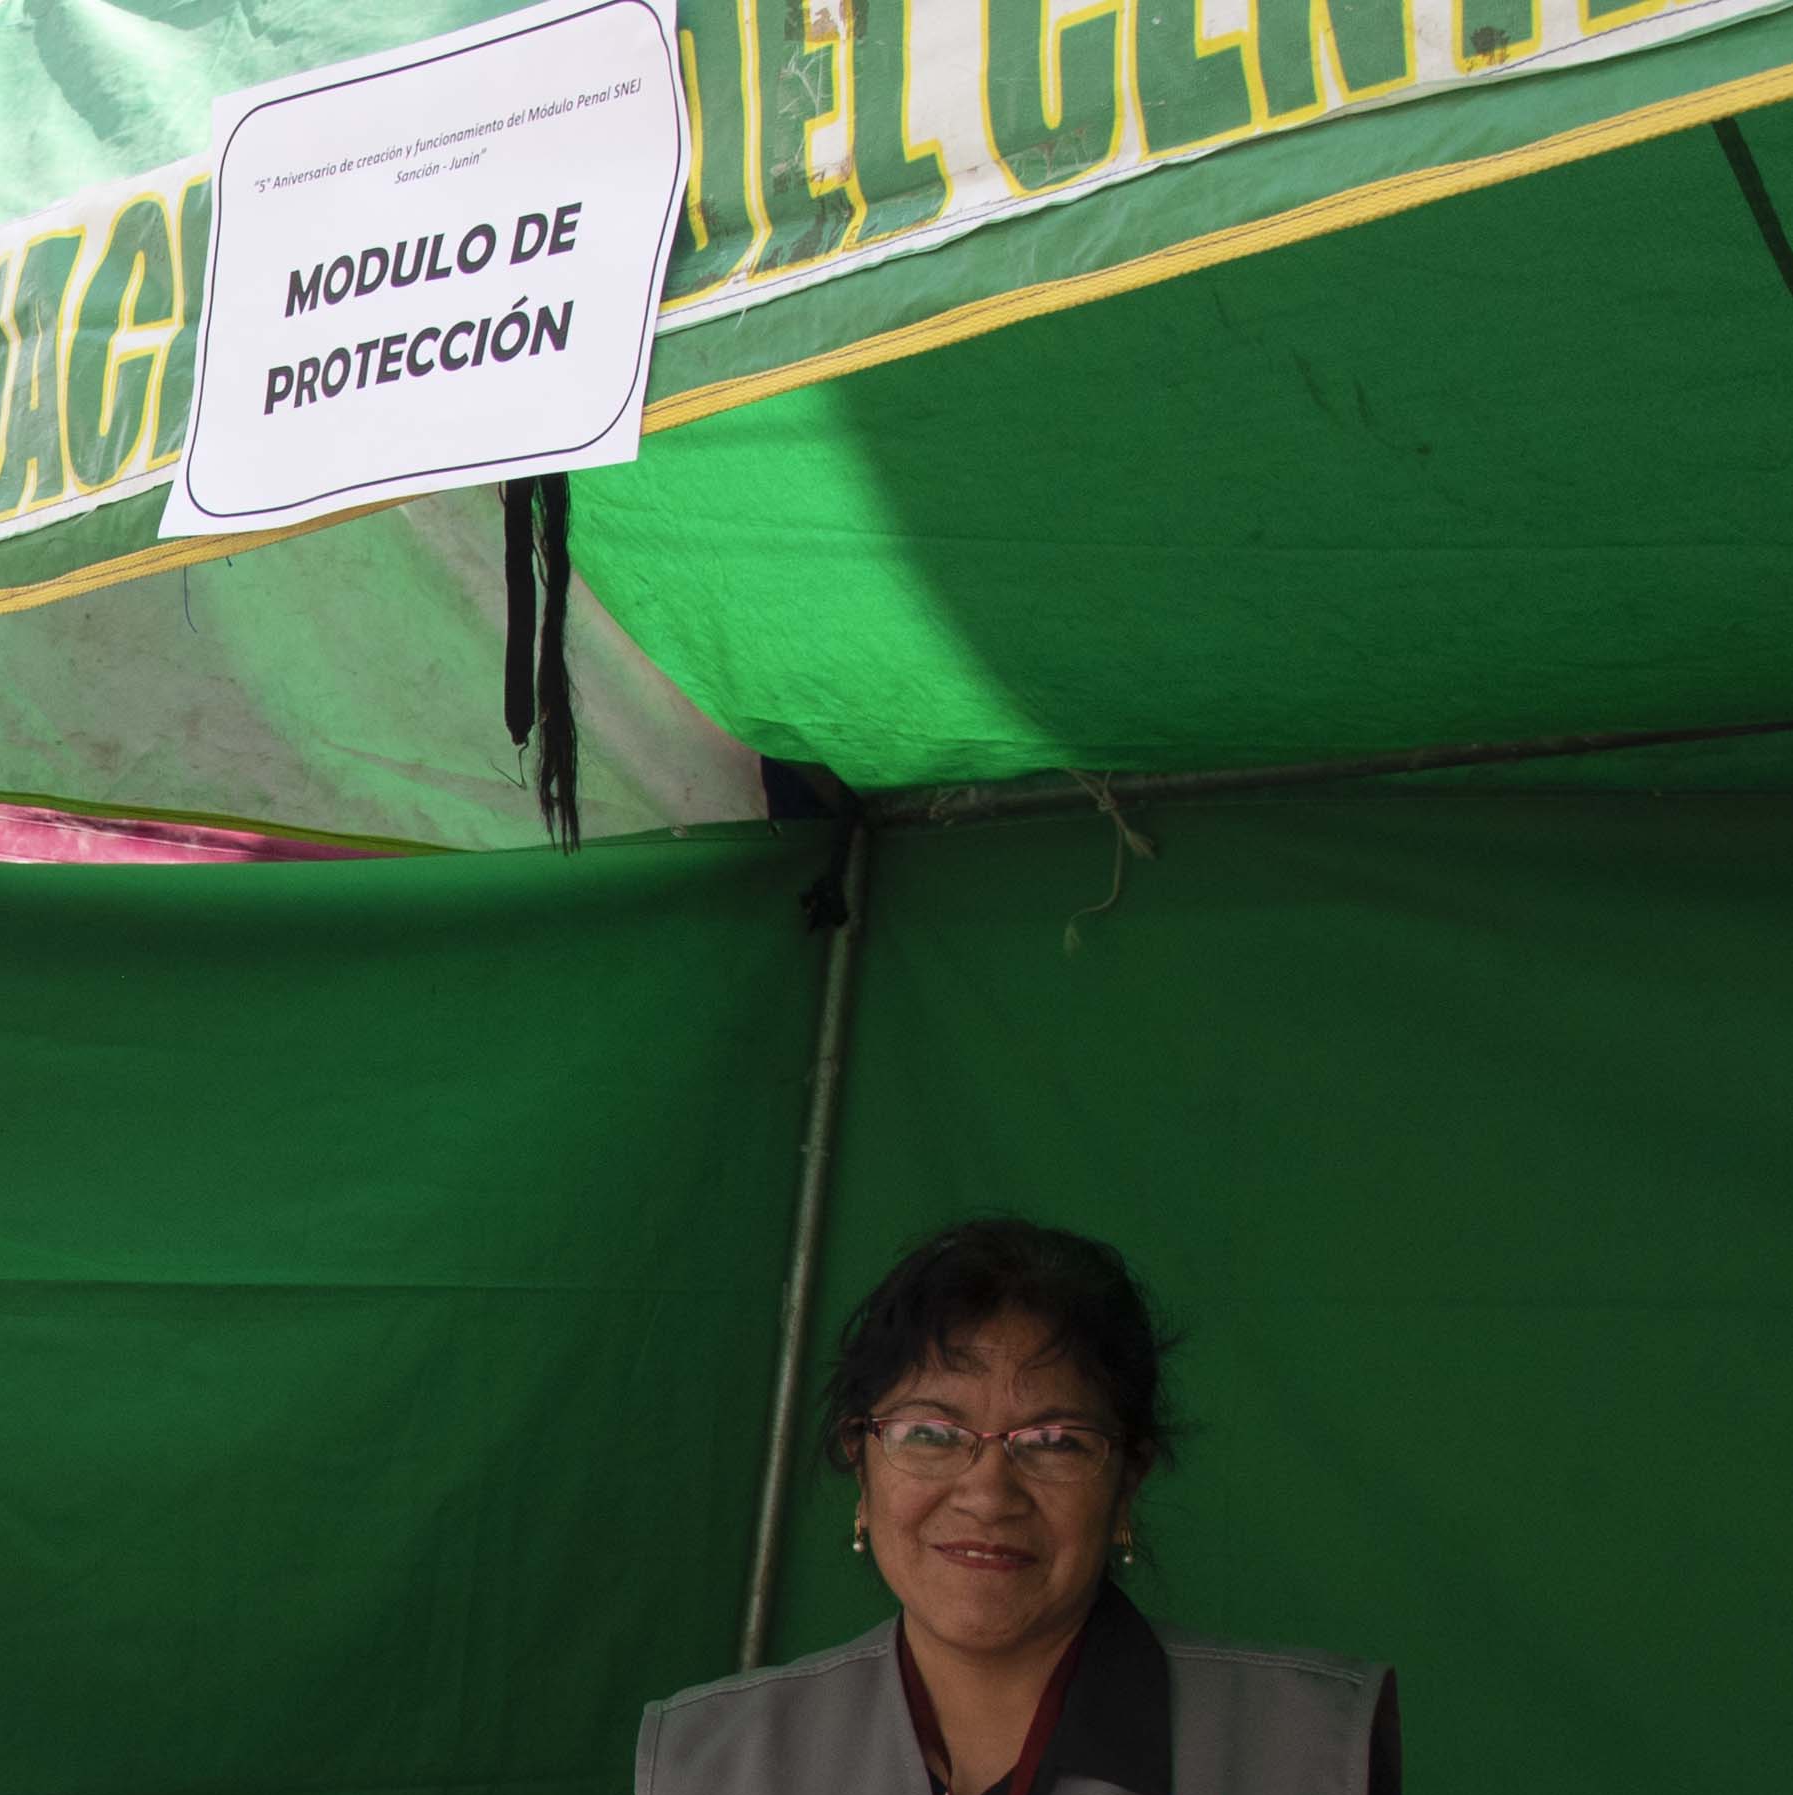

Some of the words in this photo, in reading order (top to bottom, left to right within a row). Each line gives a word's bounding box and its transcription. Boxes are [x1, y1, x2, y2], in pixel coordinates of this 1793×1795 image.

[273, 164, 337, 190] Aniversario
[340, 157, 354, 173] de
[357, 146, 403, 170] creación
[414, 118, 505, 158] funcionamiento
[507, 111, 525, 131] del
[527, 97, 573, 123] Módulo
[577, 87, 611, 110] Penal
[613, 78, 643, 101] SNEJ
[394, 162, 440, 186] Sanción
[284, 223, 498, 318] MODULO
[509, 201, 583, 265] DE
[263, 294, 575, 416] PROTECCIÓN
